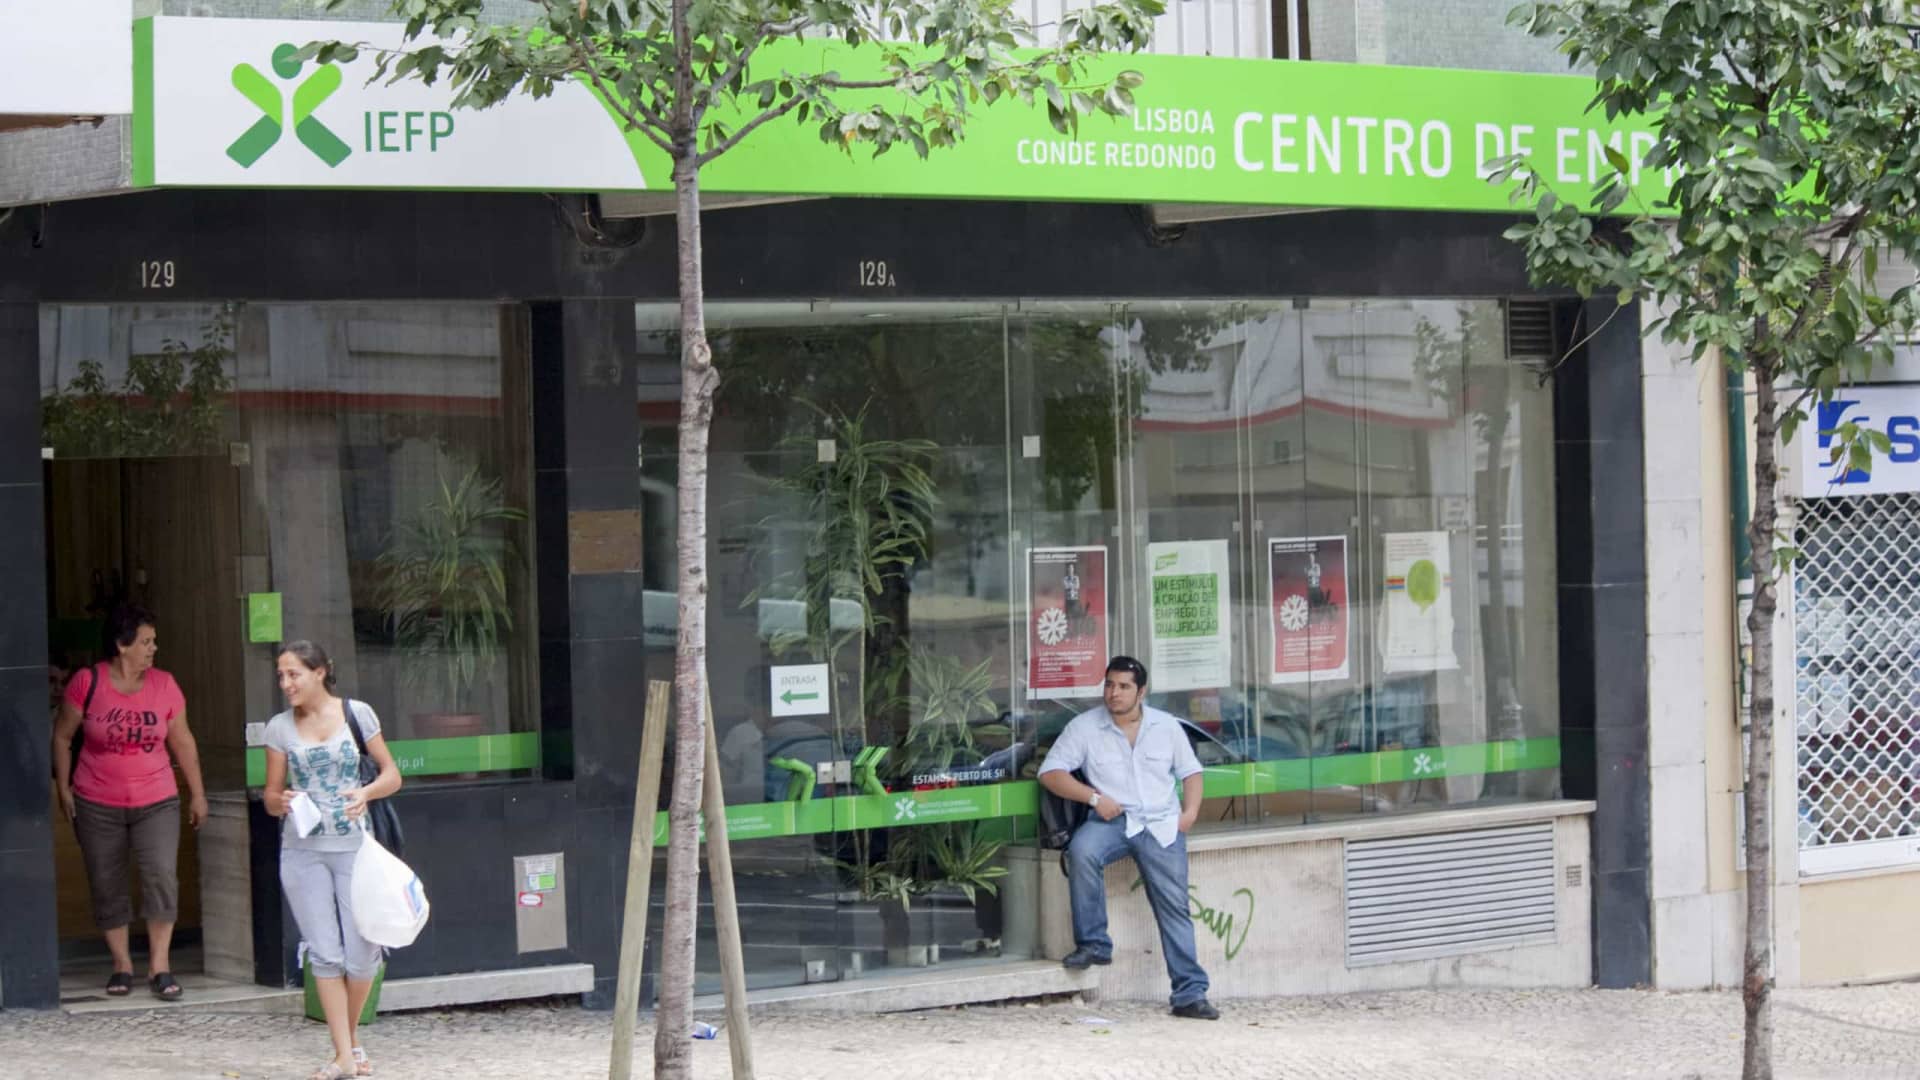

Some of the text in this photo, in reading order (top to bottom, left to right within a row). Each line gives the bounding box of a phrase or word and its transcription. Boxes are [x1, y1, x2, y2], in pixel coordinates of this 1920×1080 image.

[364, 111, 455, 152] IEFP
[1134, 108, 1215, 134] LISBOA
[1016, 139, 1216, 170] CONDE REDONDO
[1233, 111, 1453, 178] CENTRO
[1475, 122, 1535, 181] DE
[142, 260, 175, 288] 129
[1154, 578, 1168, 591] UM
[1155, 606, 1198, 619] EMPREGO
[955, 768, 980, 781] PERTO
